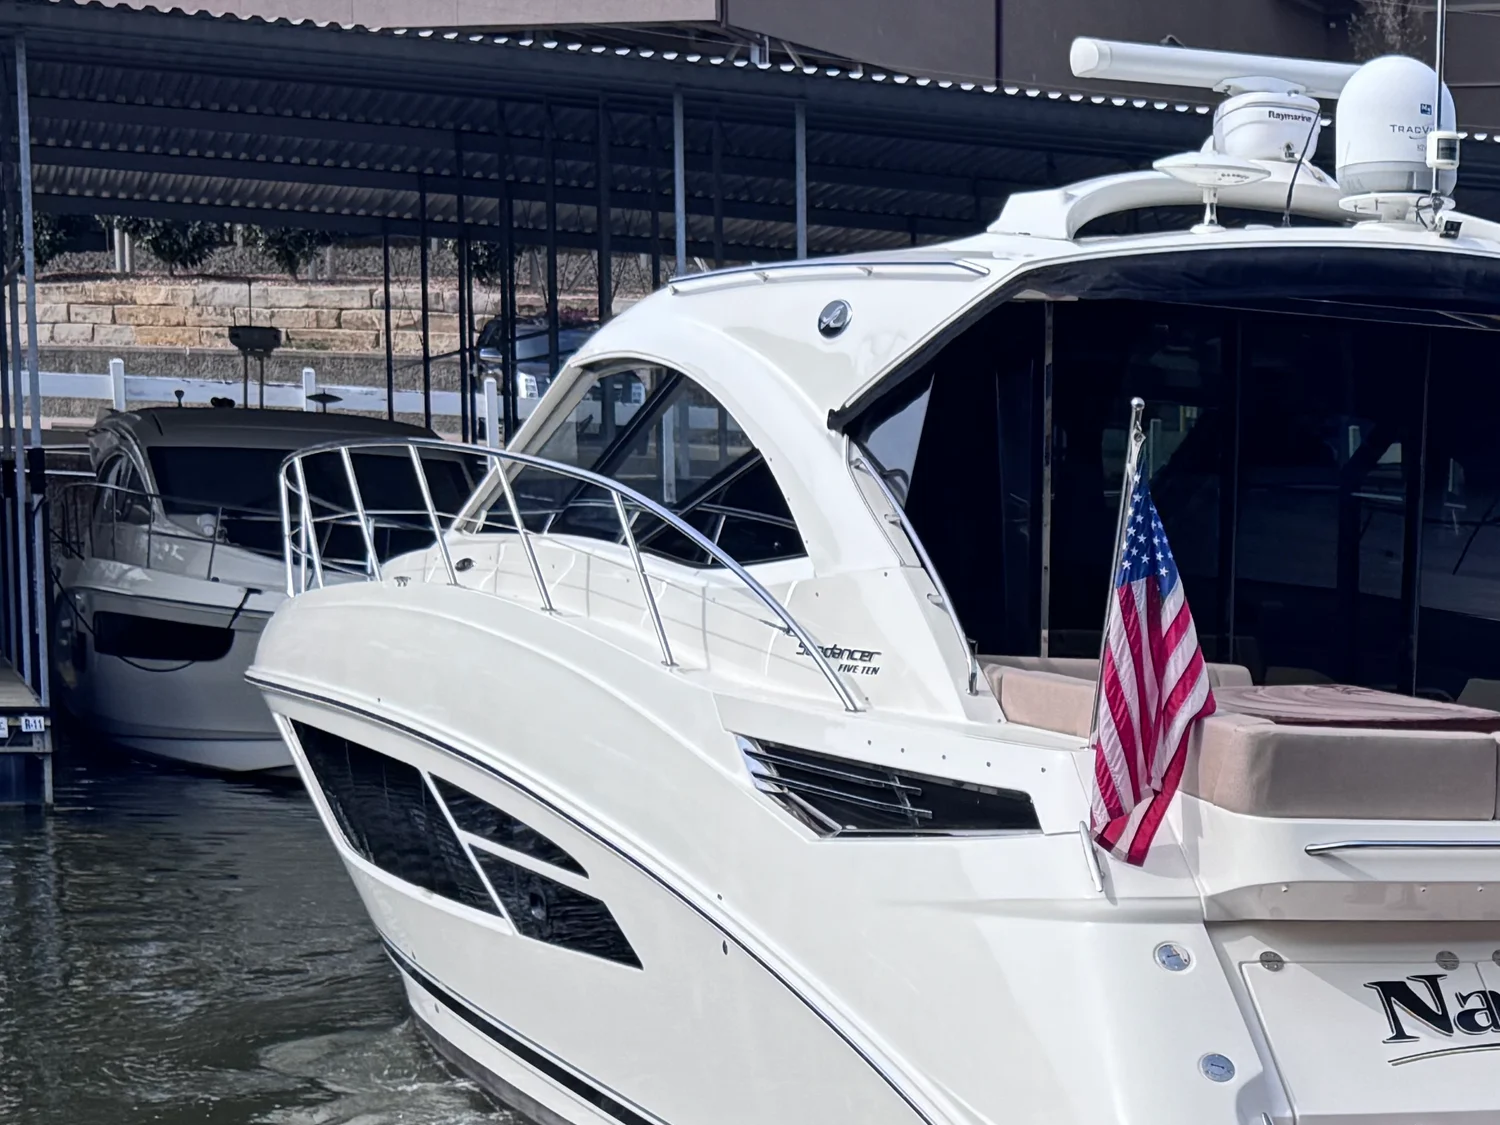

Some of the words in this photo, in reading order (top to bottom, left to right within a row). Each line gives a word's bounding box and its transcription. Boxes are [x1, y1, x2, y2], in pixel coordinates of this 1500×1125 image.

[1268, 110, 1312, 122] Raymarine
[837, 663, 859, 674] FIVE
[860, 666, 880, 676] TEN
